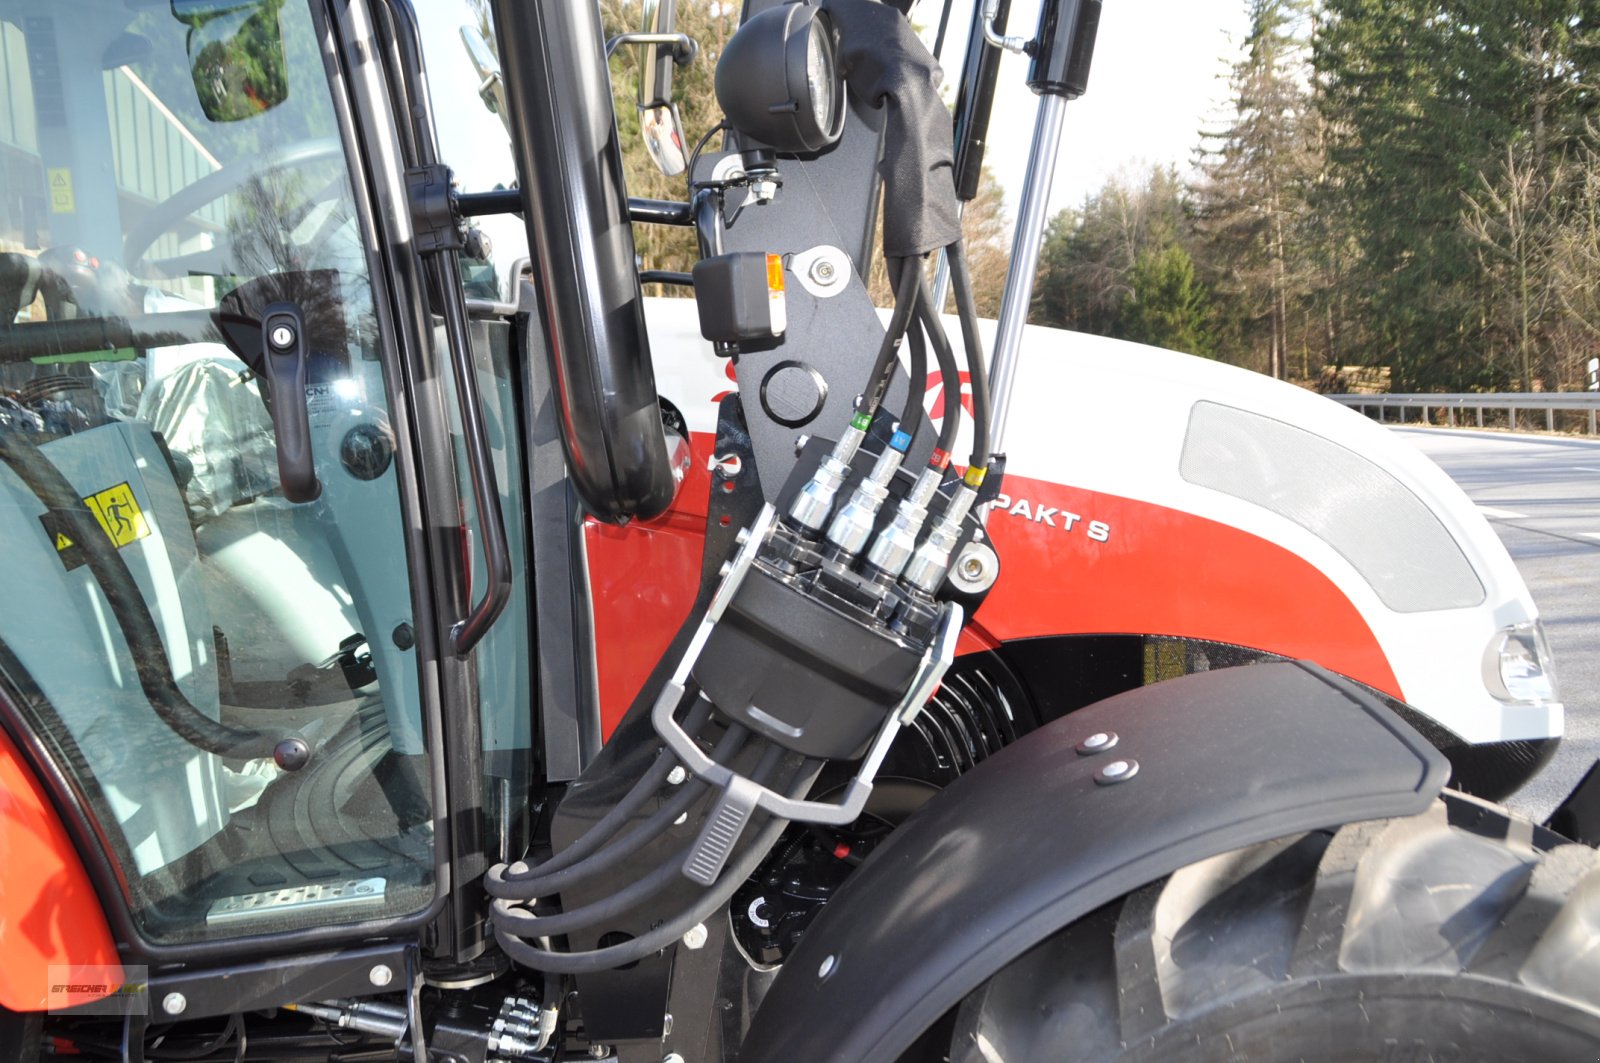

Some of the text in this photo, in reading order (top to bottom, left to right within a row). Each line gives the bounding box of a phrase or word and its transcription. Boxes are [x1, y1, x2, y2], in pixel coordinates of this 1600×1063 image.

[306, 386, 330, 396] CNH
[990, 493, 1110, 543] PAKT S
